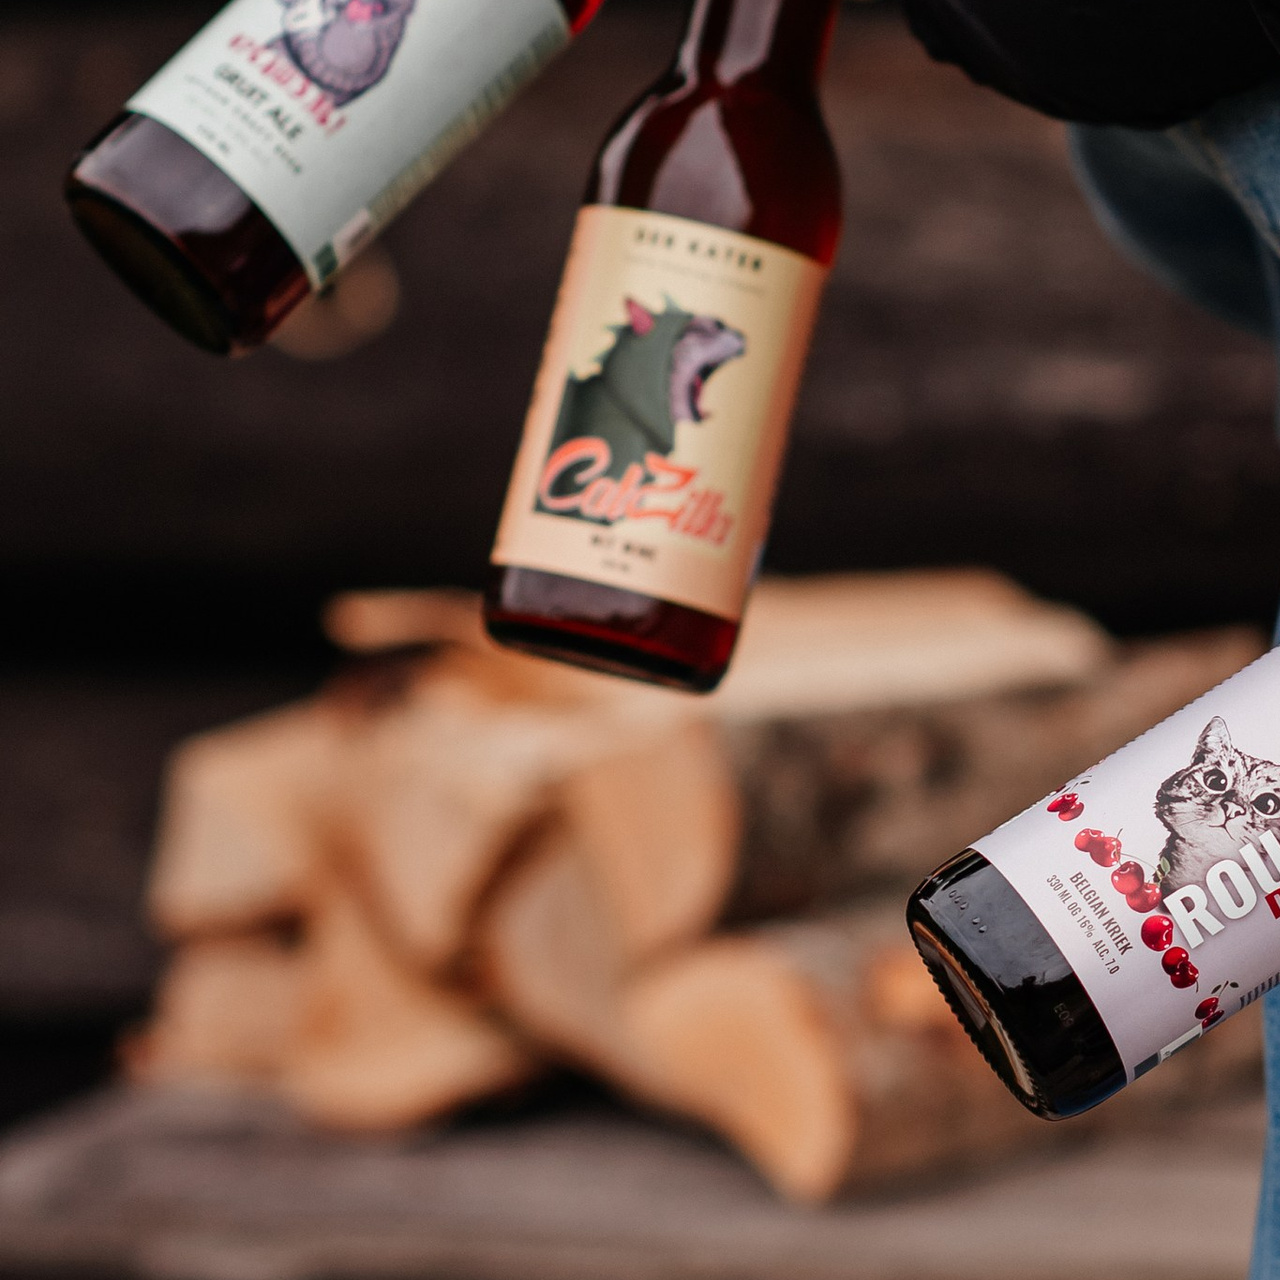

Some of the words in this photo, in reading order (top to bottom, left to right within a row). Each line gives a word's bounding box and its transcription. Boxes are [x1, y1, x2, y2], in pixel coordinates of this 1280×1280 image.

[1046, 874, 1064, 892] 330
[1057, 889, 1073, 905] ML
[1067, 901, 1082, 917] OG
[1076, 915, 1096, 938] 16%
[1092, 939, 1110, 961] ALC.
[1104, 958, 1120, 975] 7.0
[1069, 871, 1110, 920] BELGIAN
[1102, 917, 1134, 956] KRIEK
